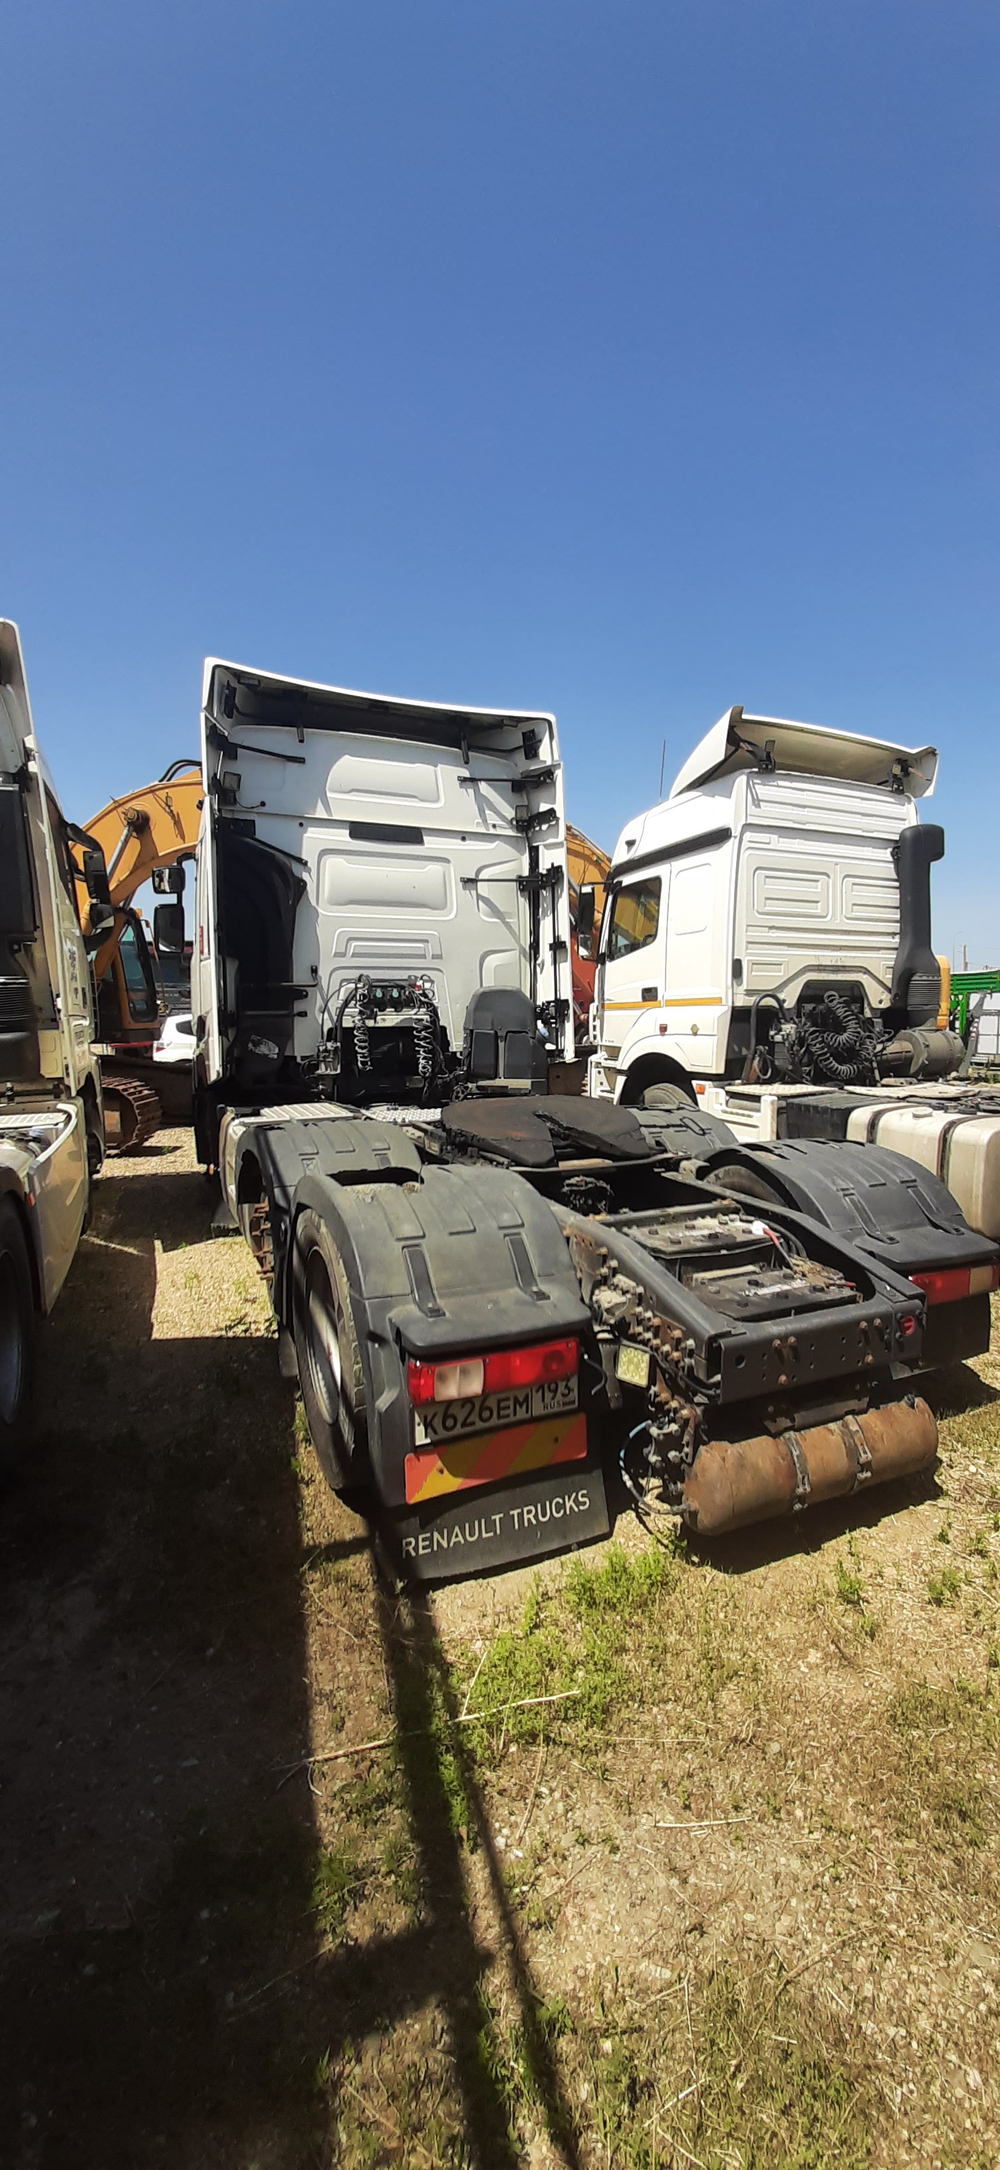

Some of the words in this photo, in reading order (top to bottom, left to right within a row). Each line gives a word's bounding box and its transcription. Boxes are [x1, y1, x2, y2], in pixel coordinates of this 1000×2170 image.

[535, 1379, 571, 1403] 193
[543, 1400, 563, 1411] RUS
[402, 1513, 505, 1558] RENAULT
[509, 1489, 590, 1530] TRUCKS
